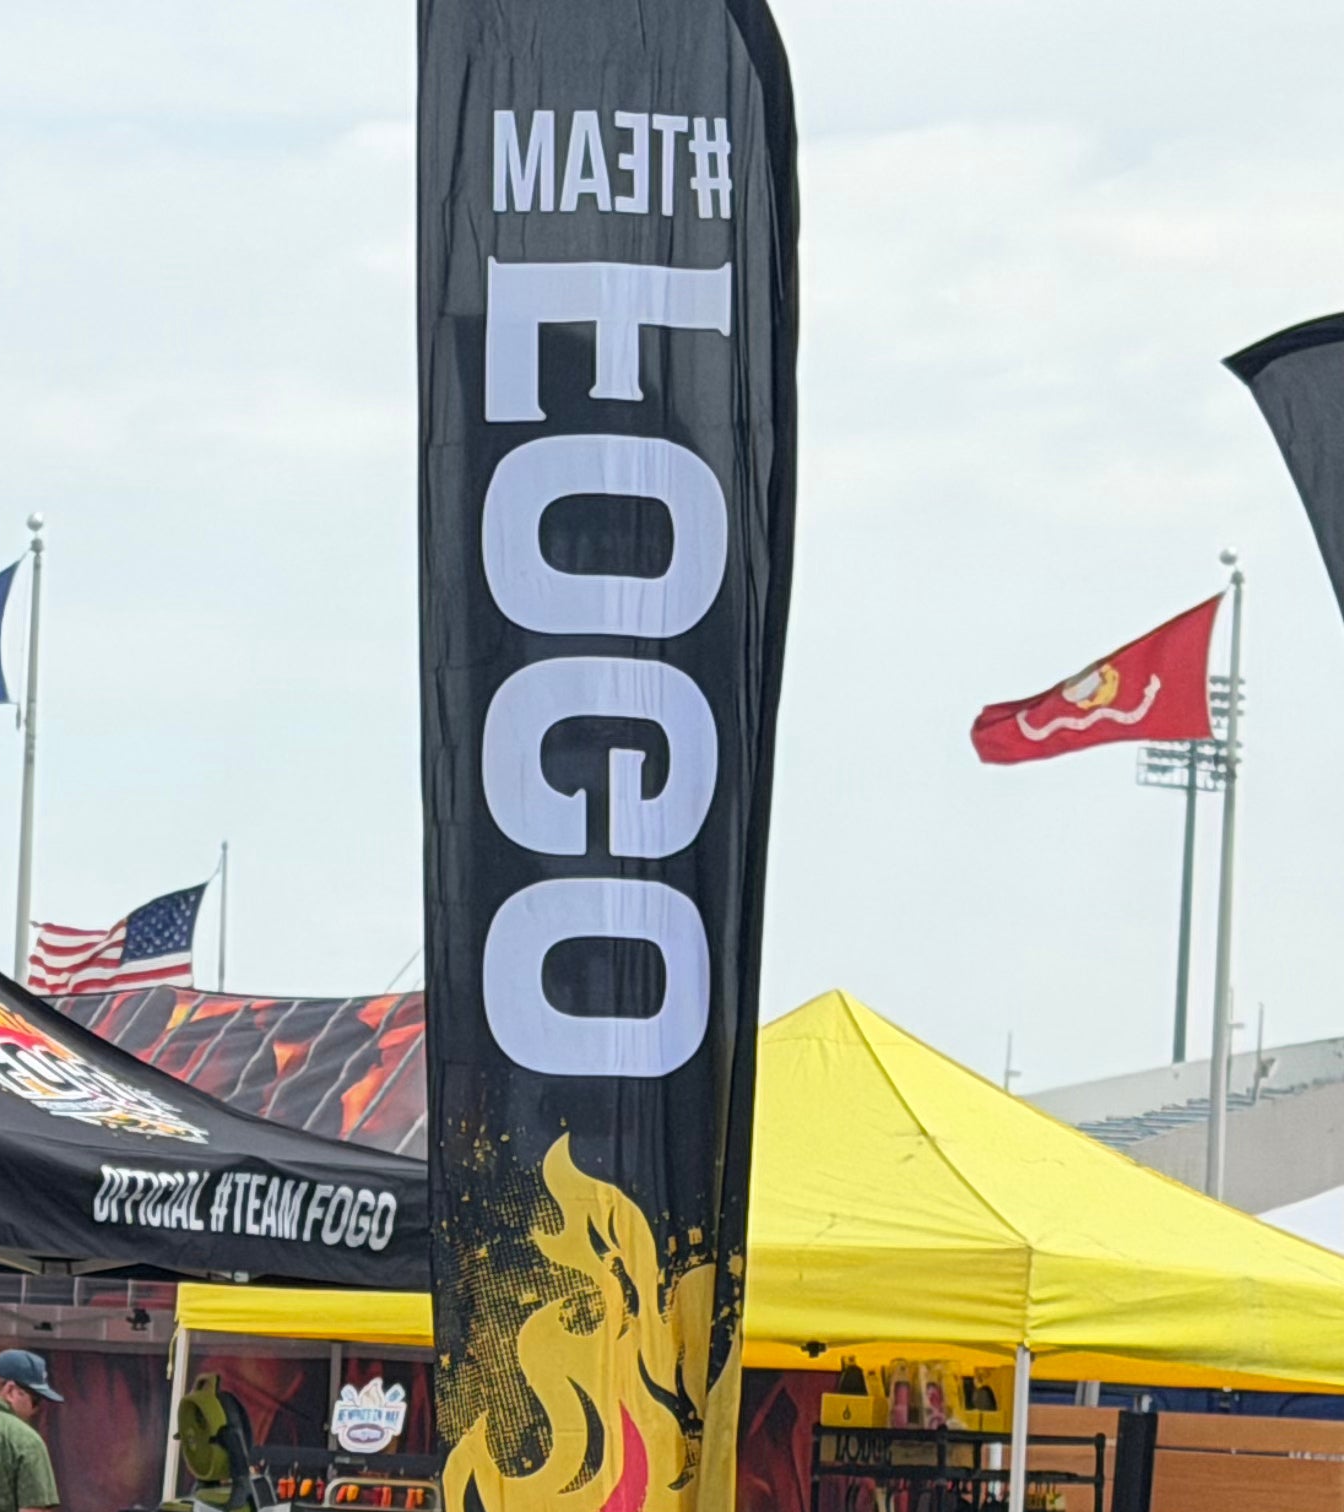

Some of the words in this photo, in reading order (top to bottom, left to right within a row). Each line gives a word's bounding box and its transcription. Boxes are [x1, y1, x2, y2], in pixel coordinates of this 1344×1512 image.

[93, 1164, 211, 1231] OFFICIAL
[210, 1171, 310, 1241] #TEAM
[302, 1183, 398, 1252] FOGO
